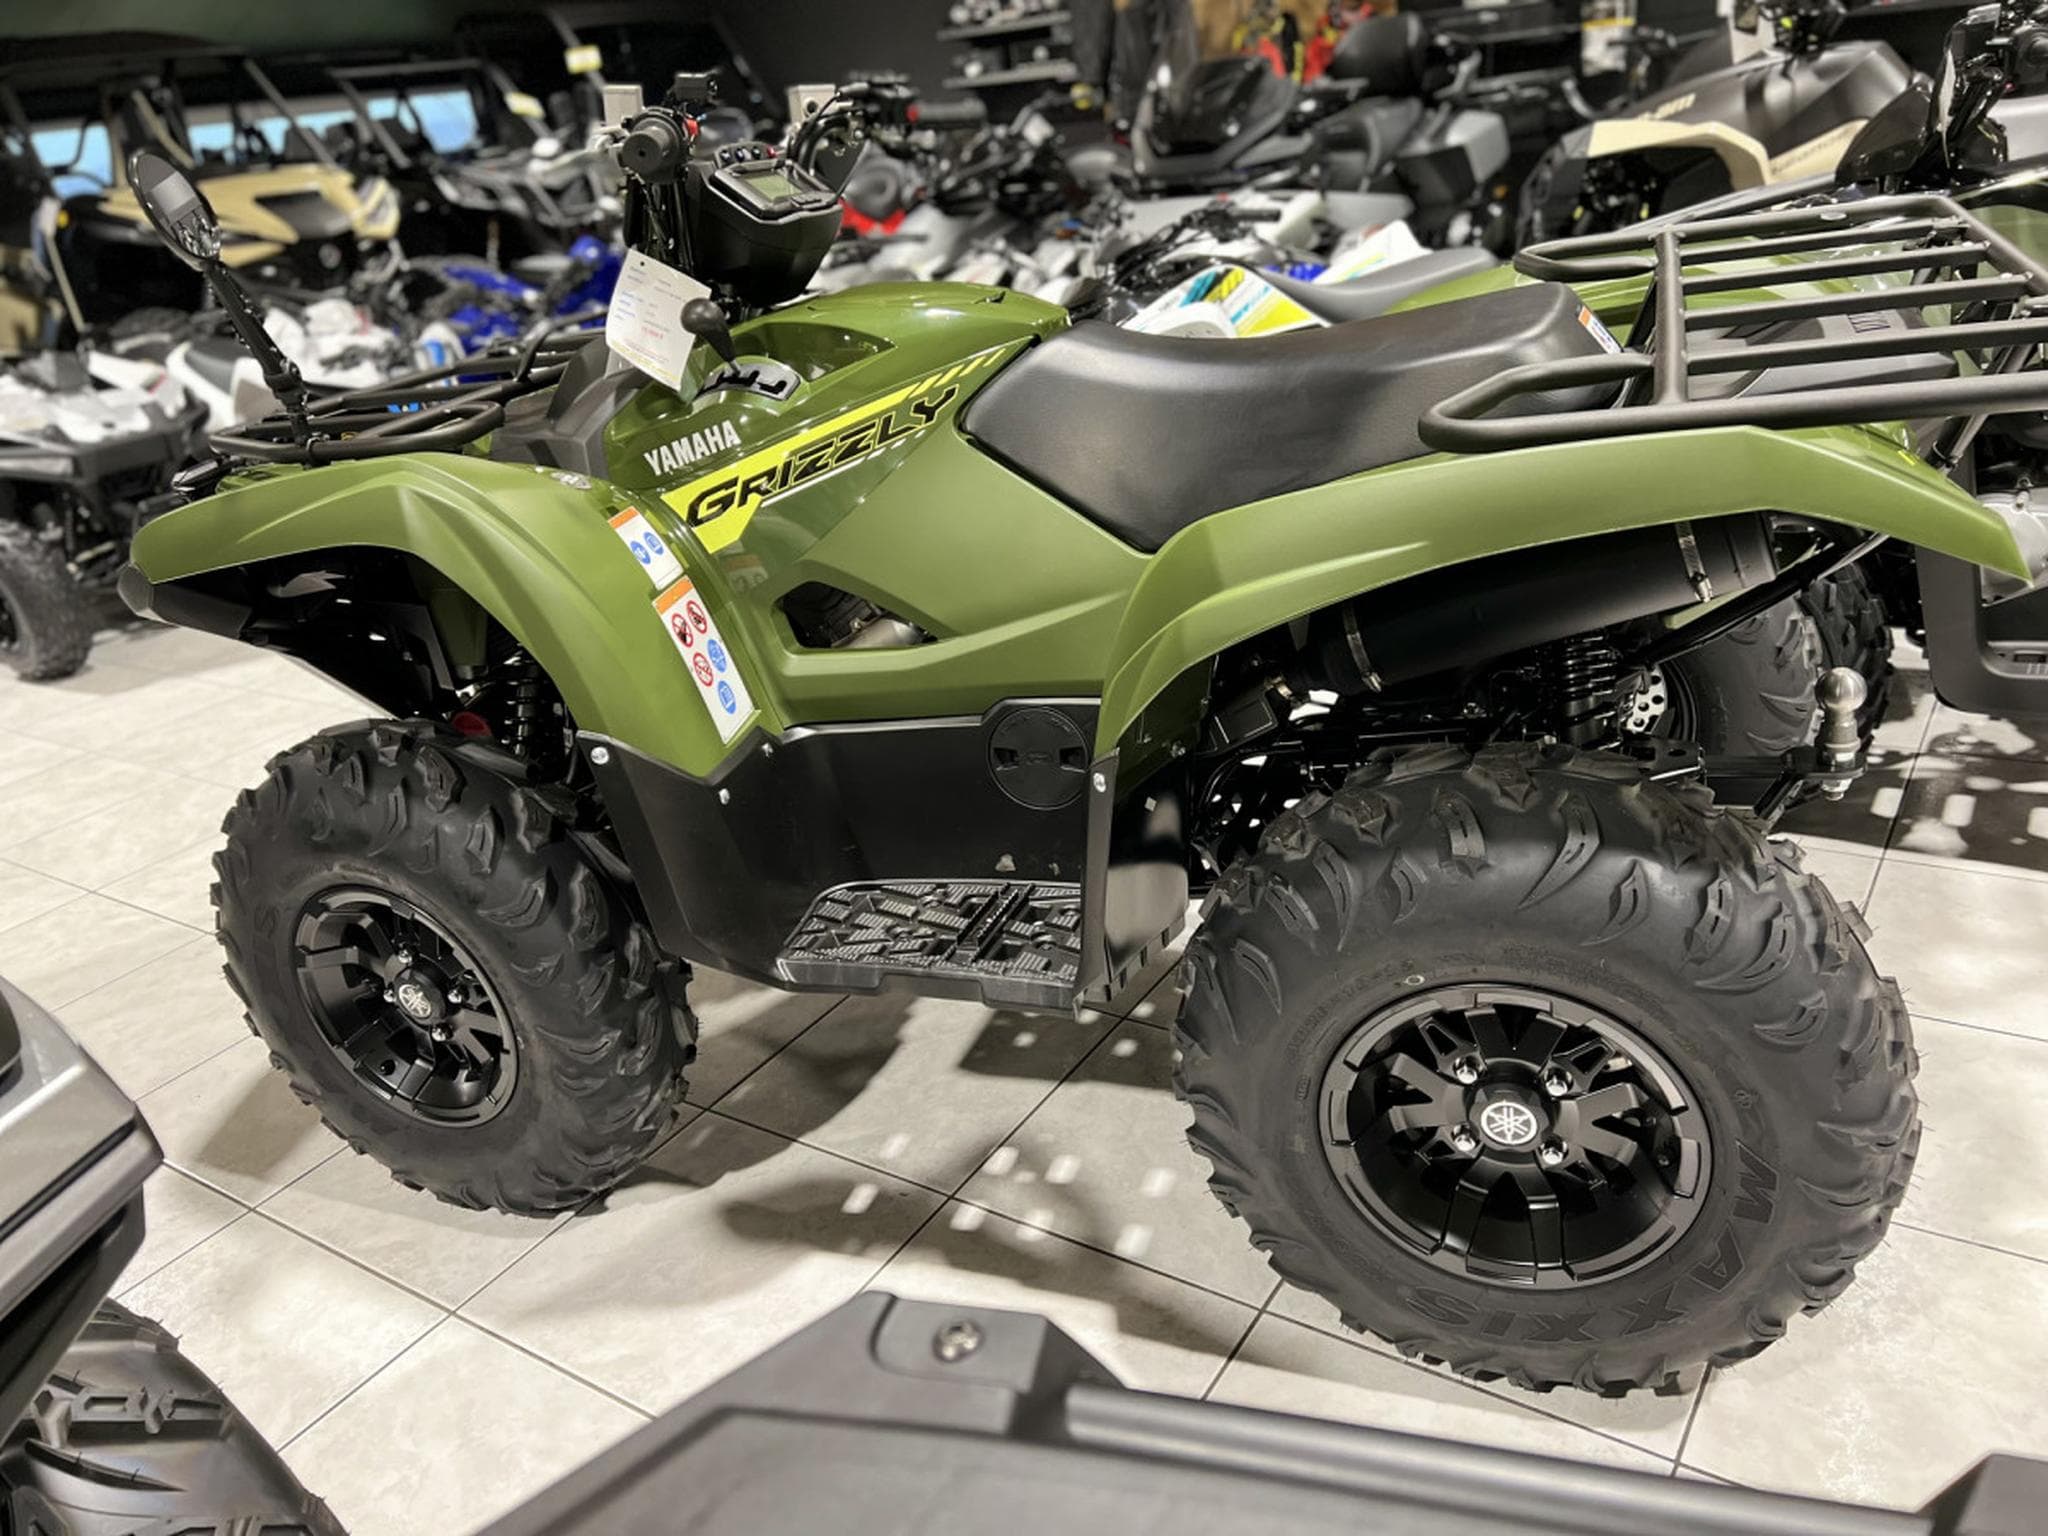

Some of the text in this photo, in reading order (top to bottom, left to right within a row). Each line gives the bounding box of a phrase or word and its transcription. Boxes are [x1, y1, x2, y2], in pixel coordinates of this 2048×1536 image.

[643, 420, 742, 477] YAMAHA
[685, 384, 959, 528] GRIZZLY
[1405, 1139, 1780, 1342] MAXXIS
